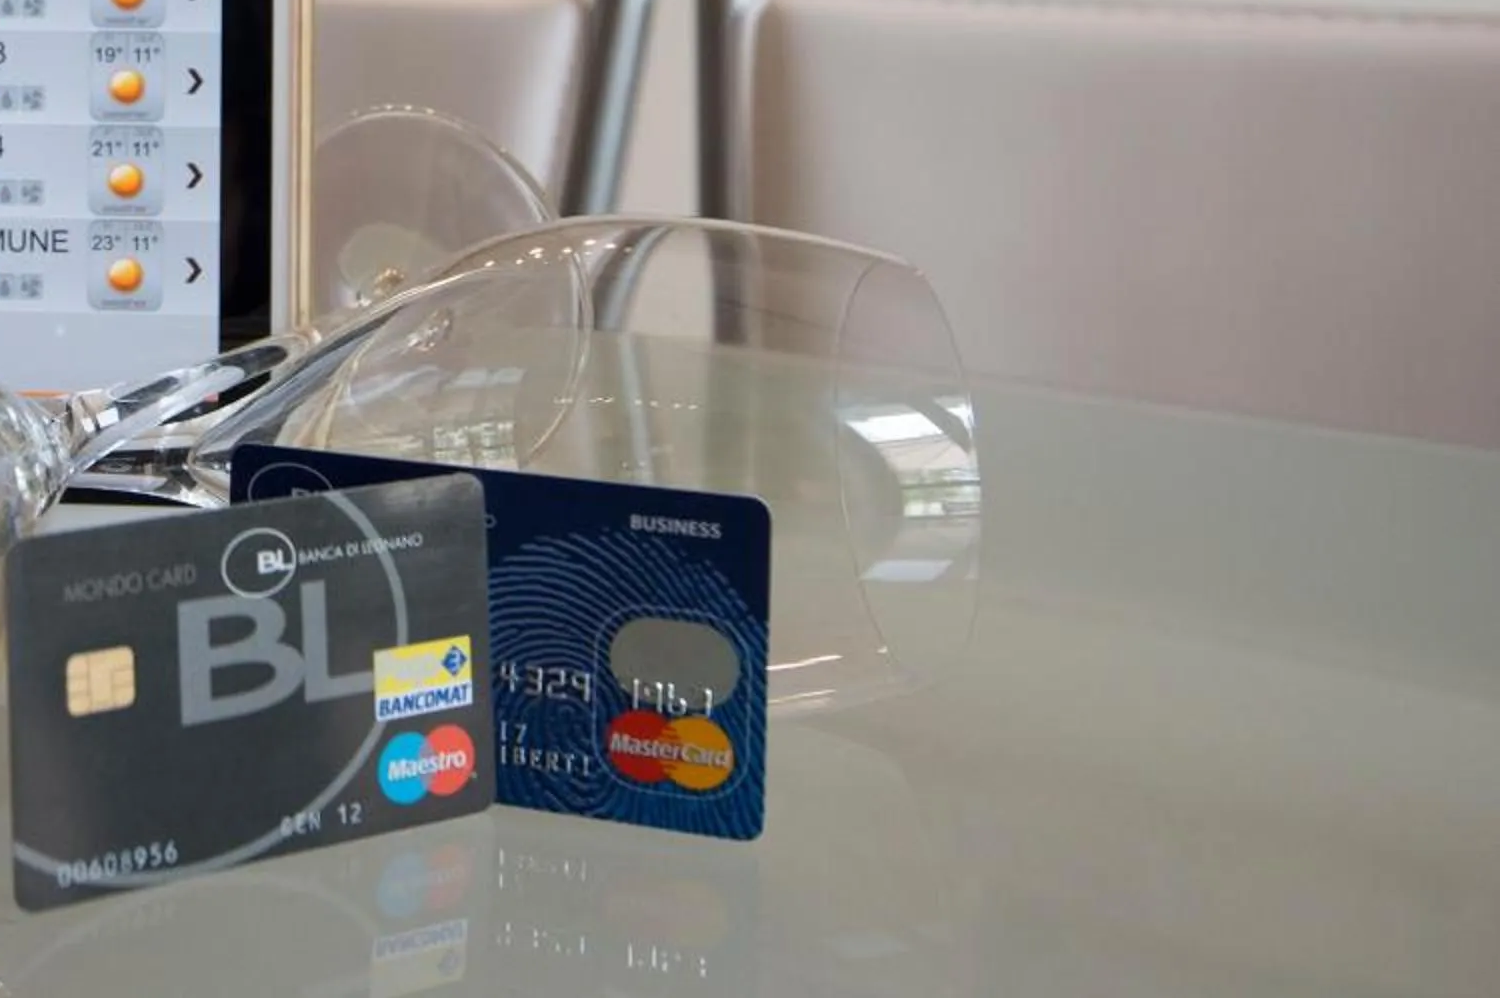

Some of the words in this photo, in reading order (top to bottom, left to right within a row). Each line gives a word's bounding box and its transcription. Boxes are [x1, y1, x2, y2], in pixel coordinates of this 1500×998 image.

[629, 514, 722, 540] BUSINESS
[255, 547, 296, 575] BL
[298, 544, 344, 565] BANCA
[63, 572, 144, 602] MONDO
[146, 564, 197, 592] CARD
[176, 580, 374, 728] BL
[378, 683, 472, 718] BANCOMAT
[387, 750, 467, 783] Maestro
[609, 732, 731, 768] MasterCard
[336, 803, 362, 825] 12
